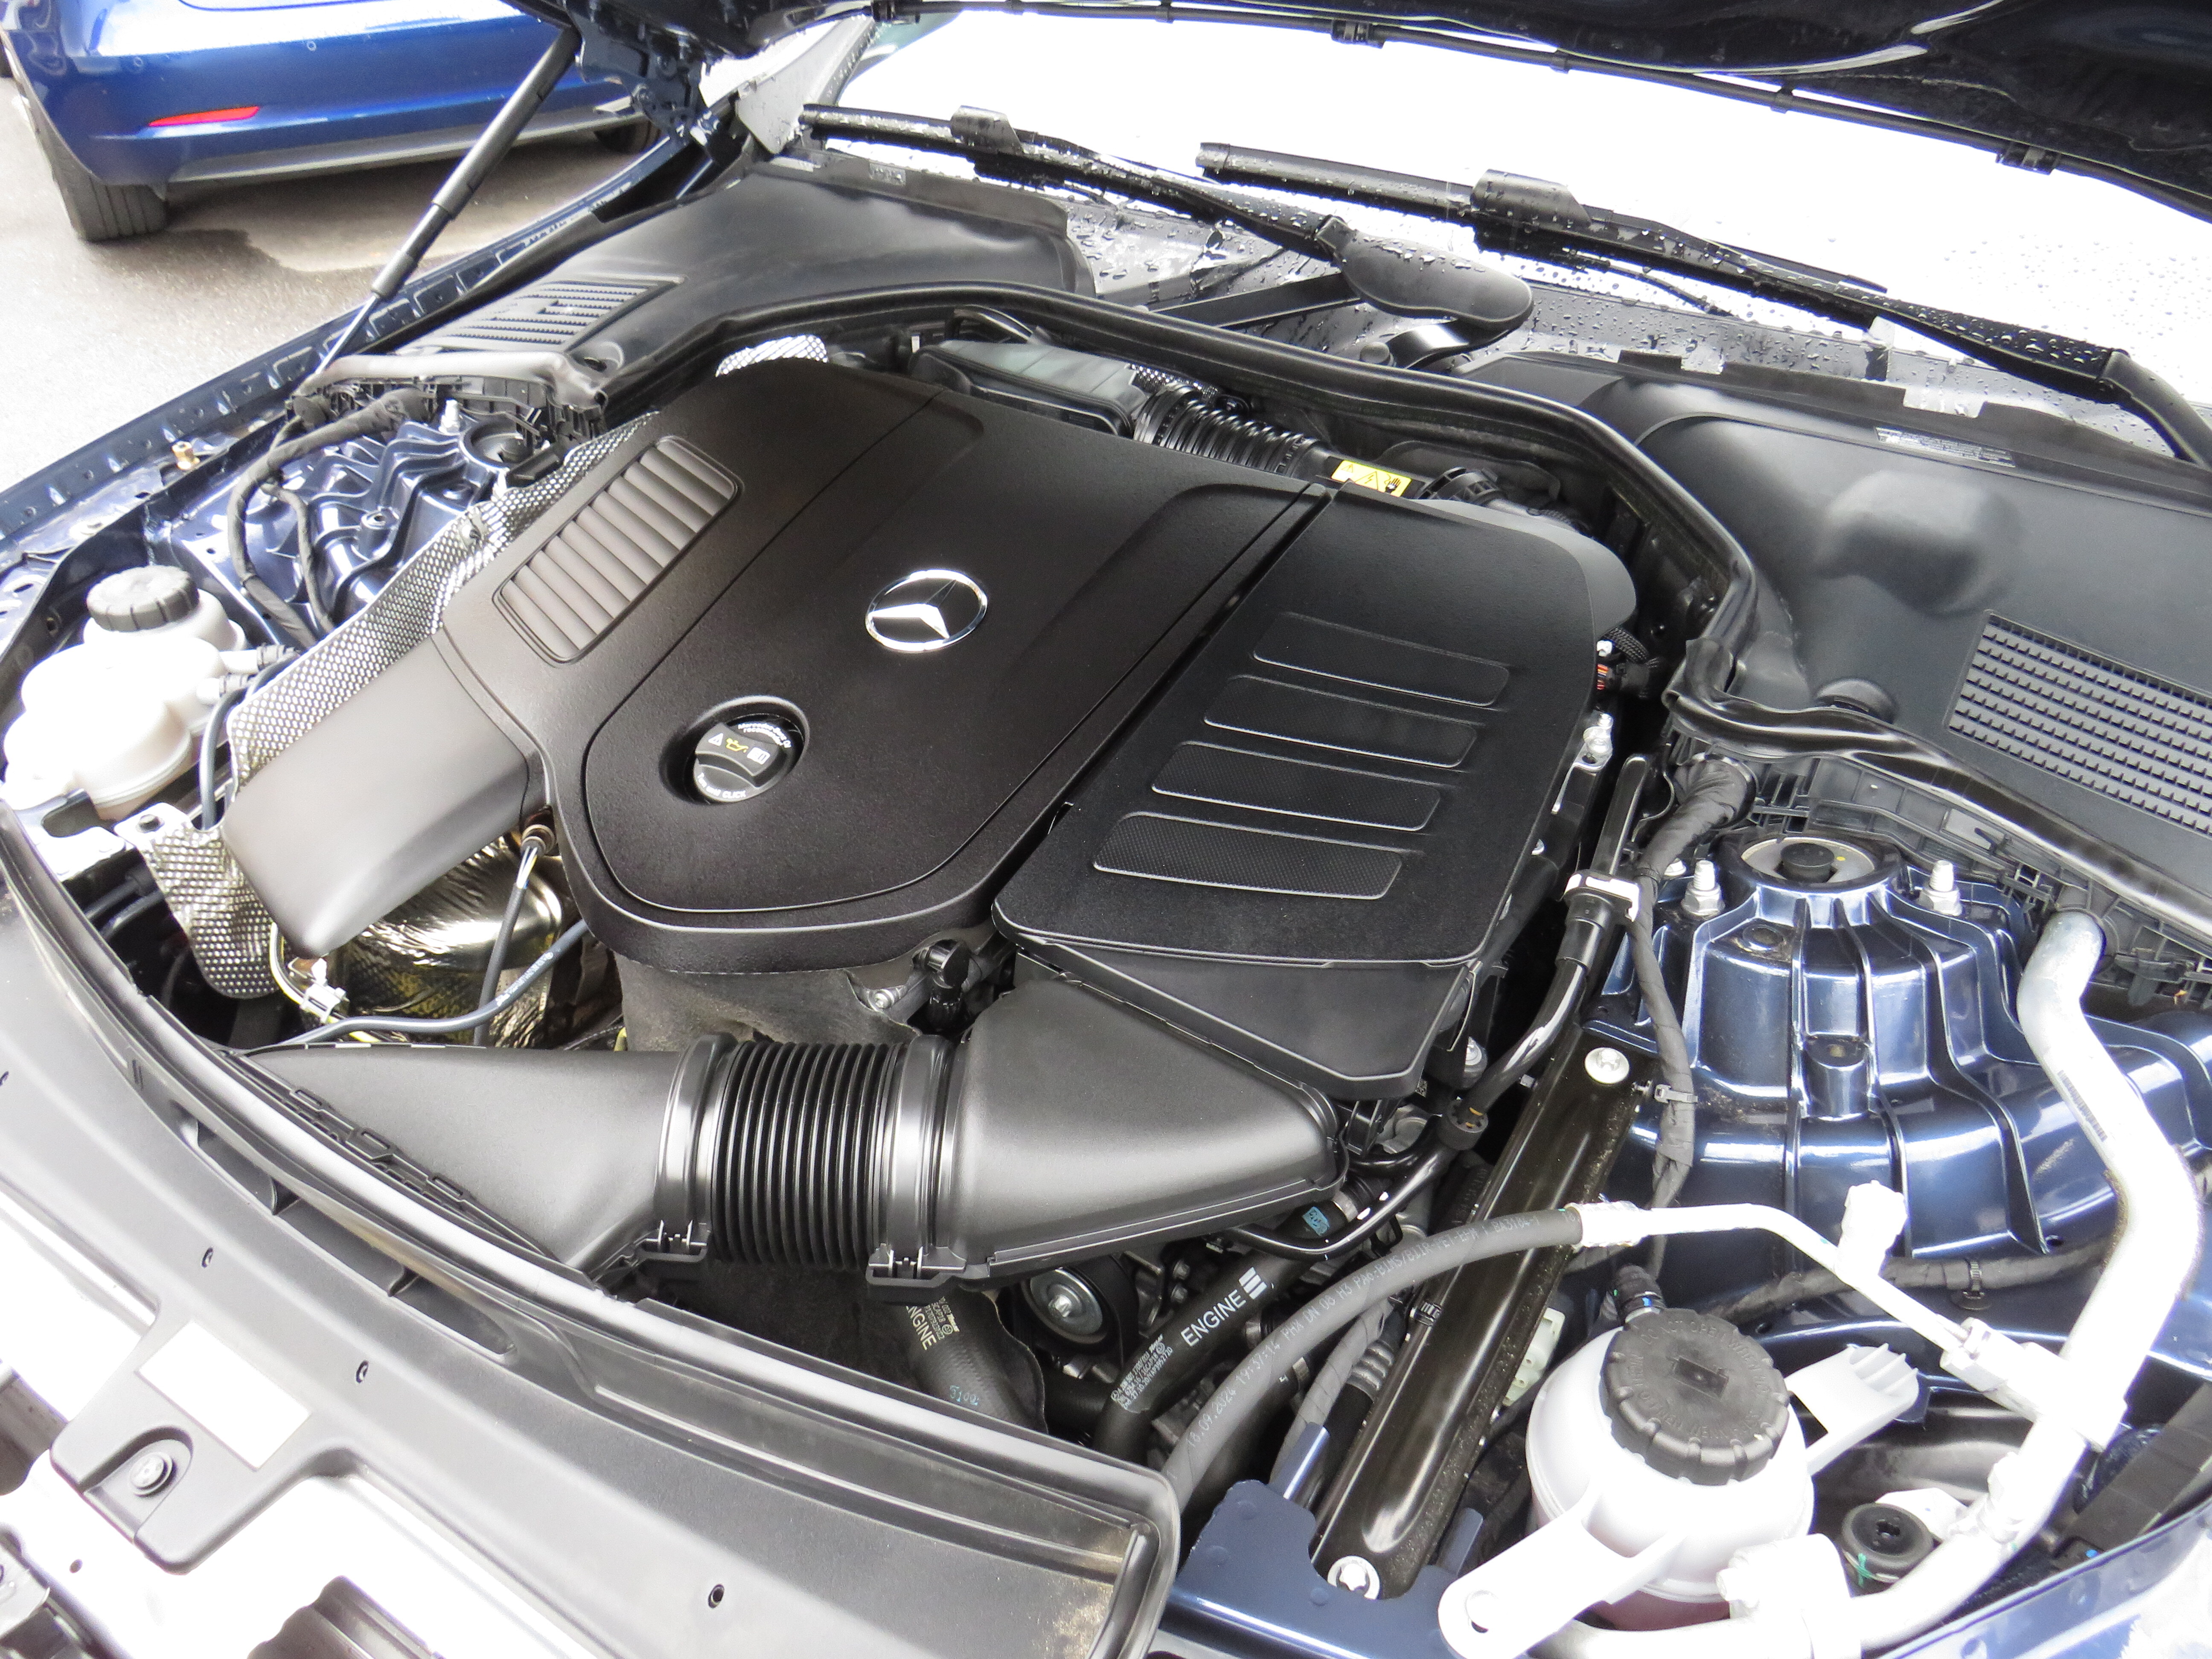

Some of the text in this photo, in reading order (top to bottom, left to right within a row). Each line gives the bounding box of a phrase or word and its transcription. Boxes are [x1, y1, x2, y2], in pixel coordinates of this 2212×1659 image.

[722, 790, 746, 799] CLICK
[906, 1306, 937, 1351] NGINE
[1181, 1289, 1246, 1347] ENGINE
